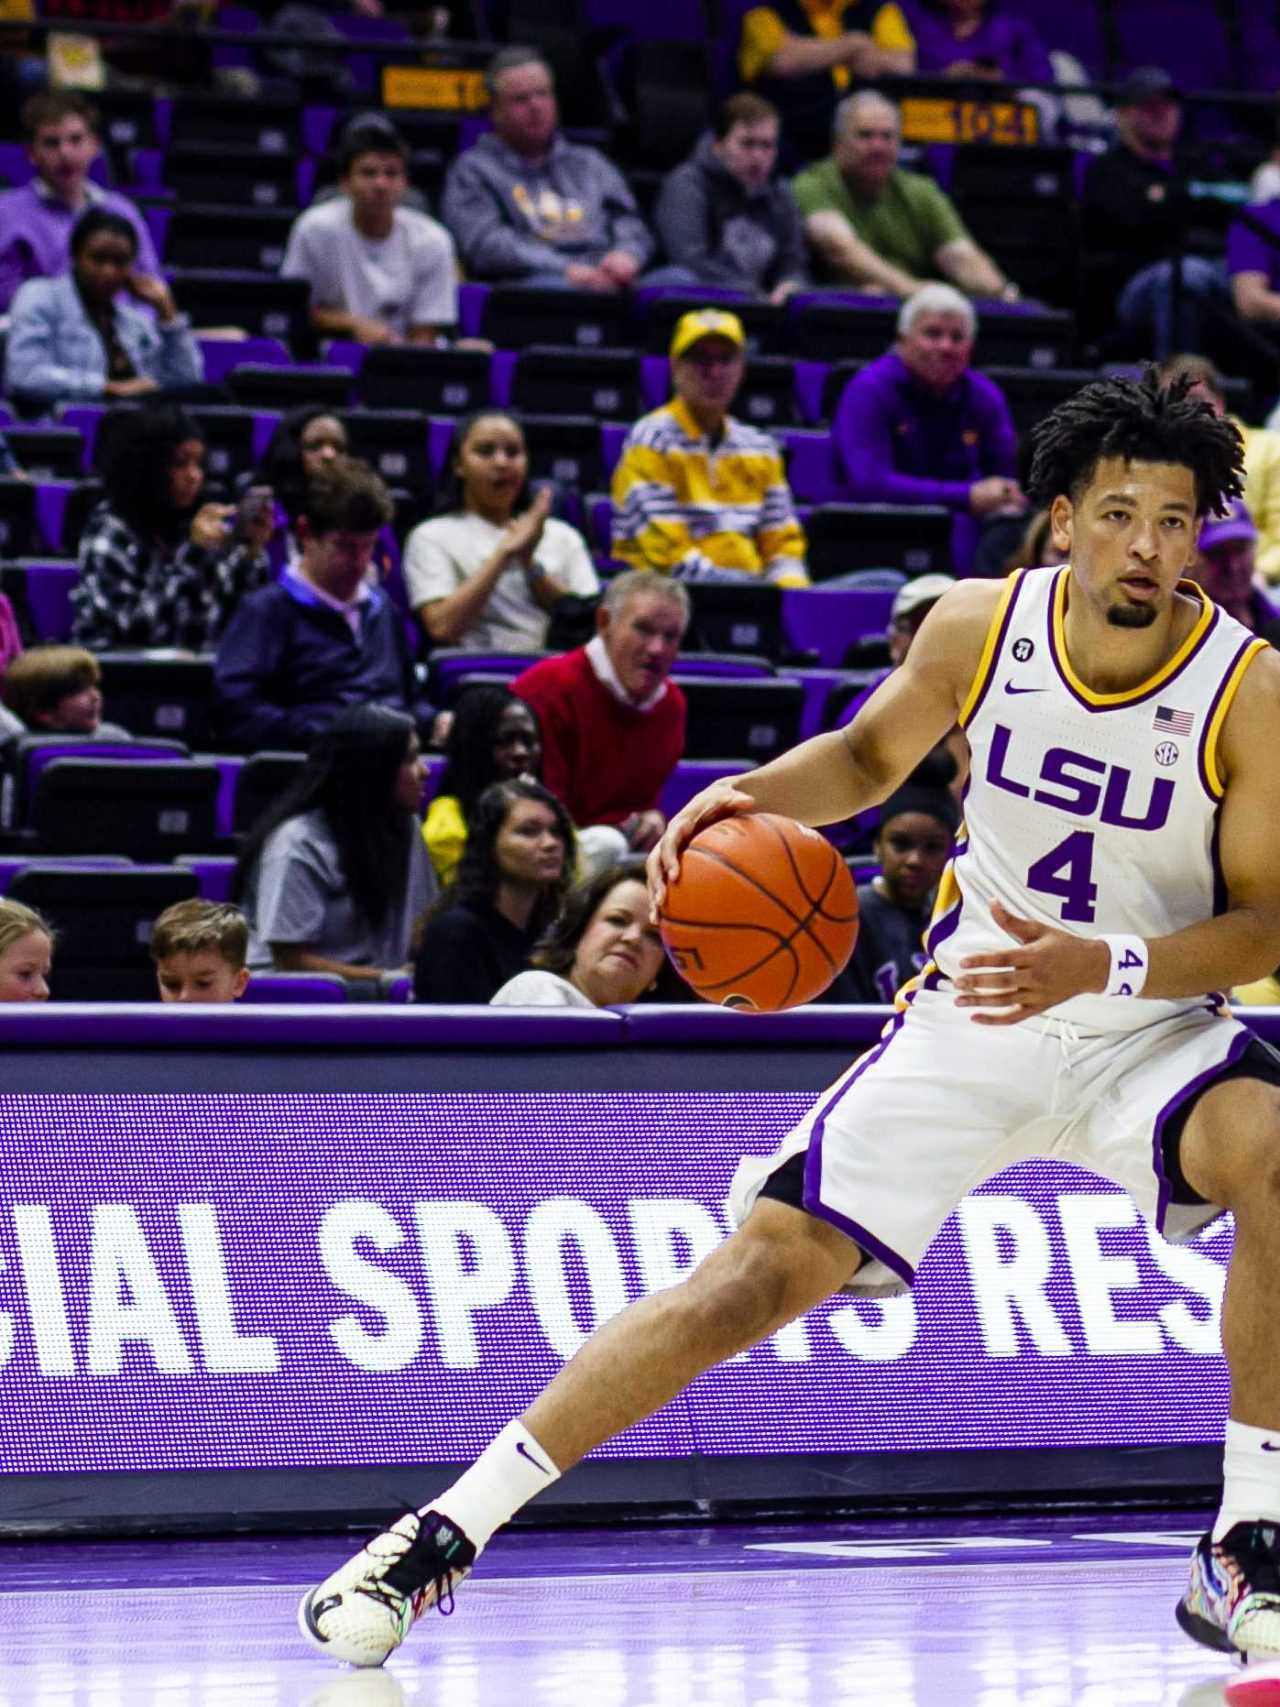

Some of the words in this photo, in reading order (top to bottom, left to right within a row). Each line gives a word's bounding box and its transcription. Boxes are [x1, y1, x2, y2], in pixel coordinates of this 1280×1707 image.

[985, 723, 1176, 831] LSU
[1027, 830, 1098, 923] 4
[0, 1201, 281, 1376] IAL
[318, 1195, 919, 1371] SPOR
